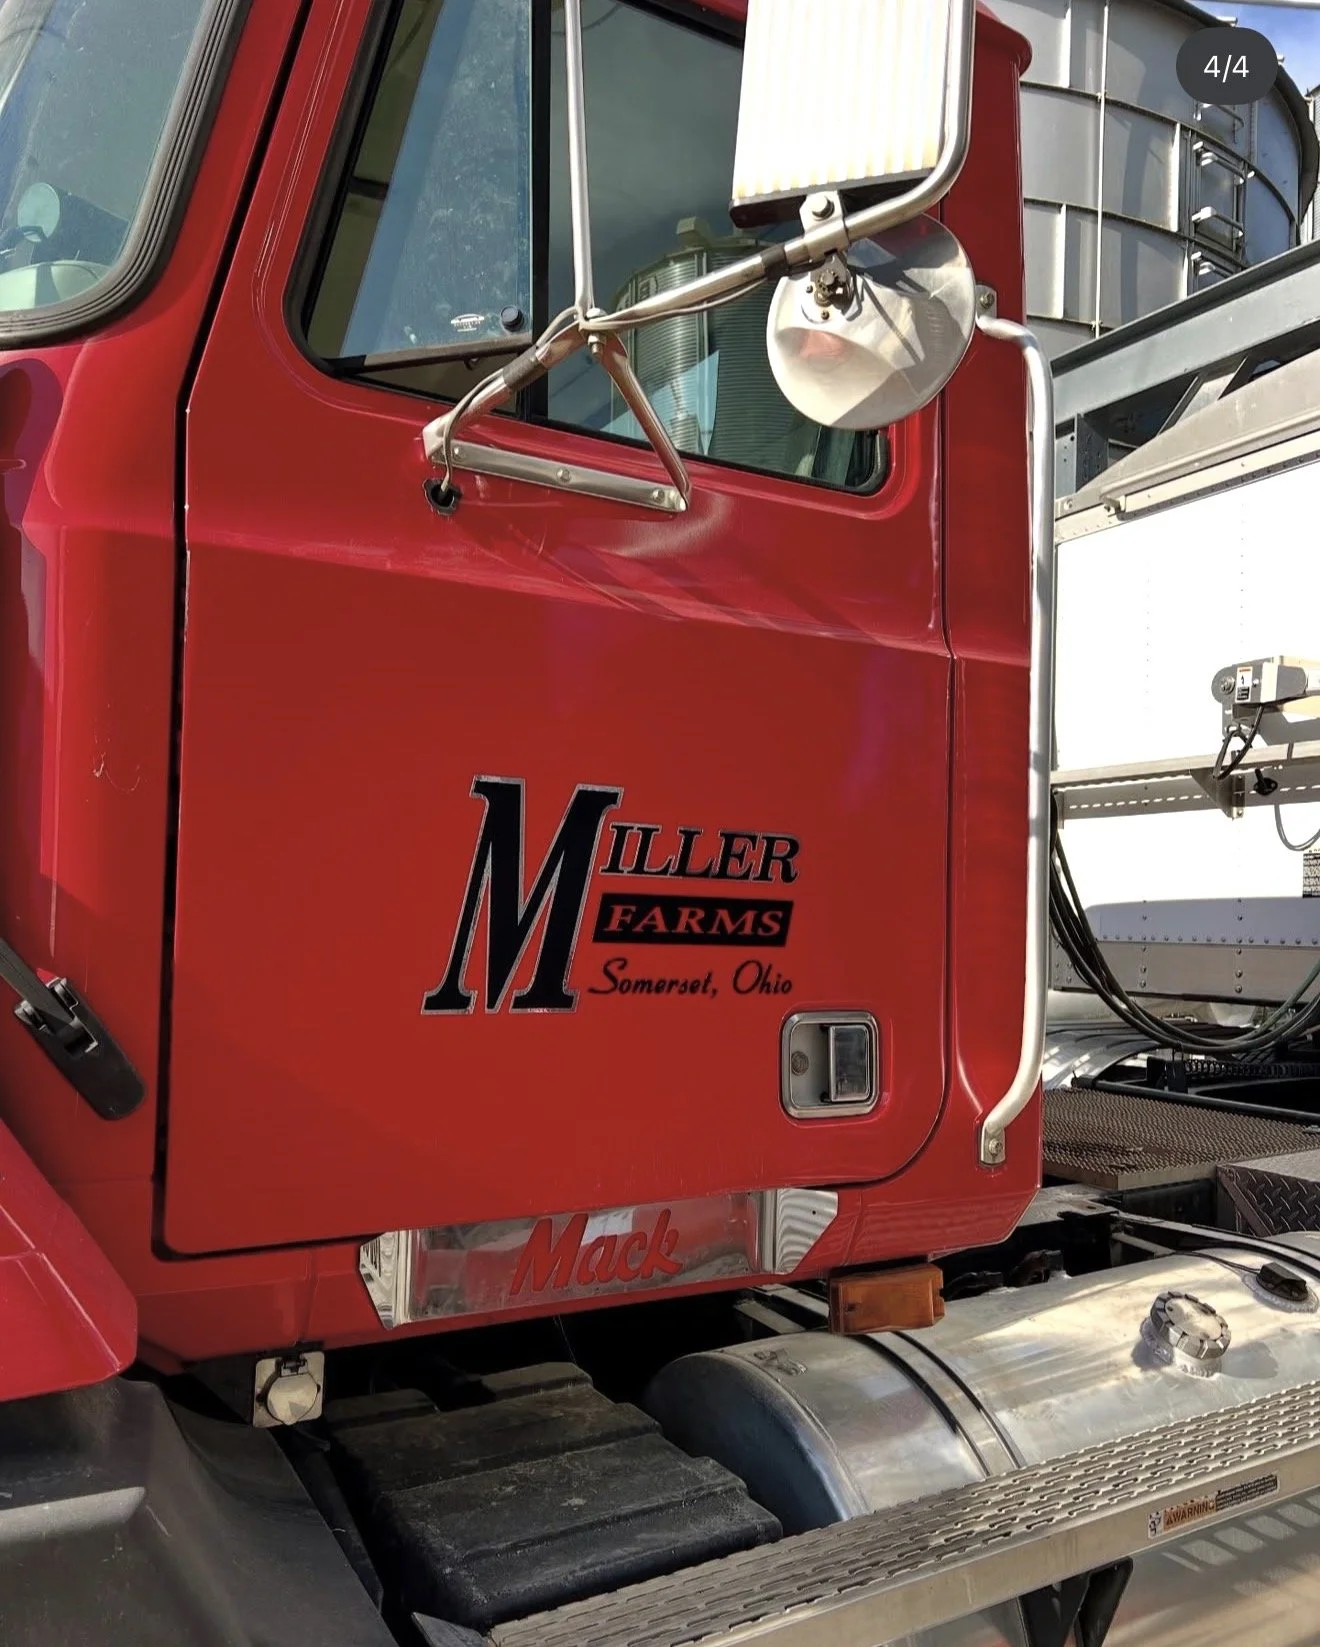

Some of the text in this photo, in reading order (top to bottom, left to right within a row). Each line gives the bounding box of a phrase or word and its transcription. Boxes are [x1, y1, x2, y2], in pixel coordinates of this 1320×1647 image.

[420, 774, 801, 1015] MILLER
[604, 904, 784, 937] FARMS
[588, 957, 793, 999] Somerset, Ohio
[509, 1207, 683, 1297] Mack
[1172, 1500, 1216, 1523] WARNING
